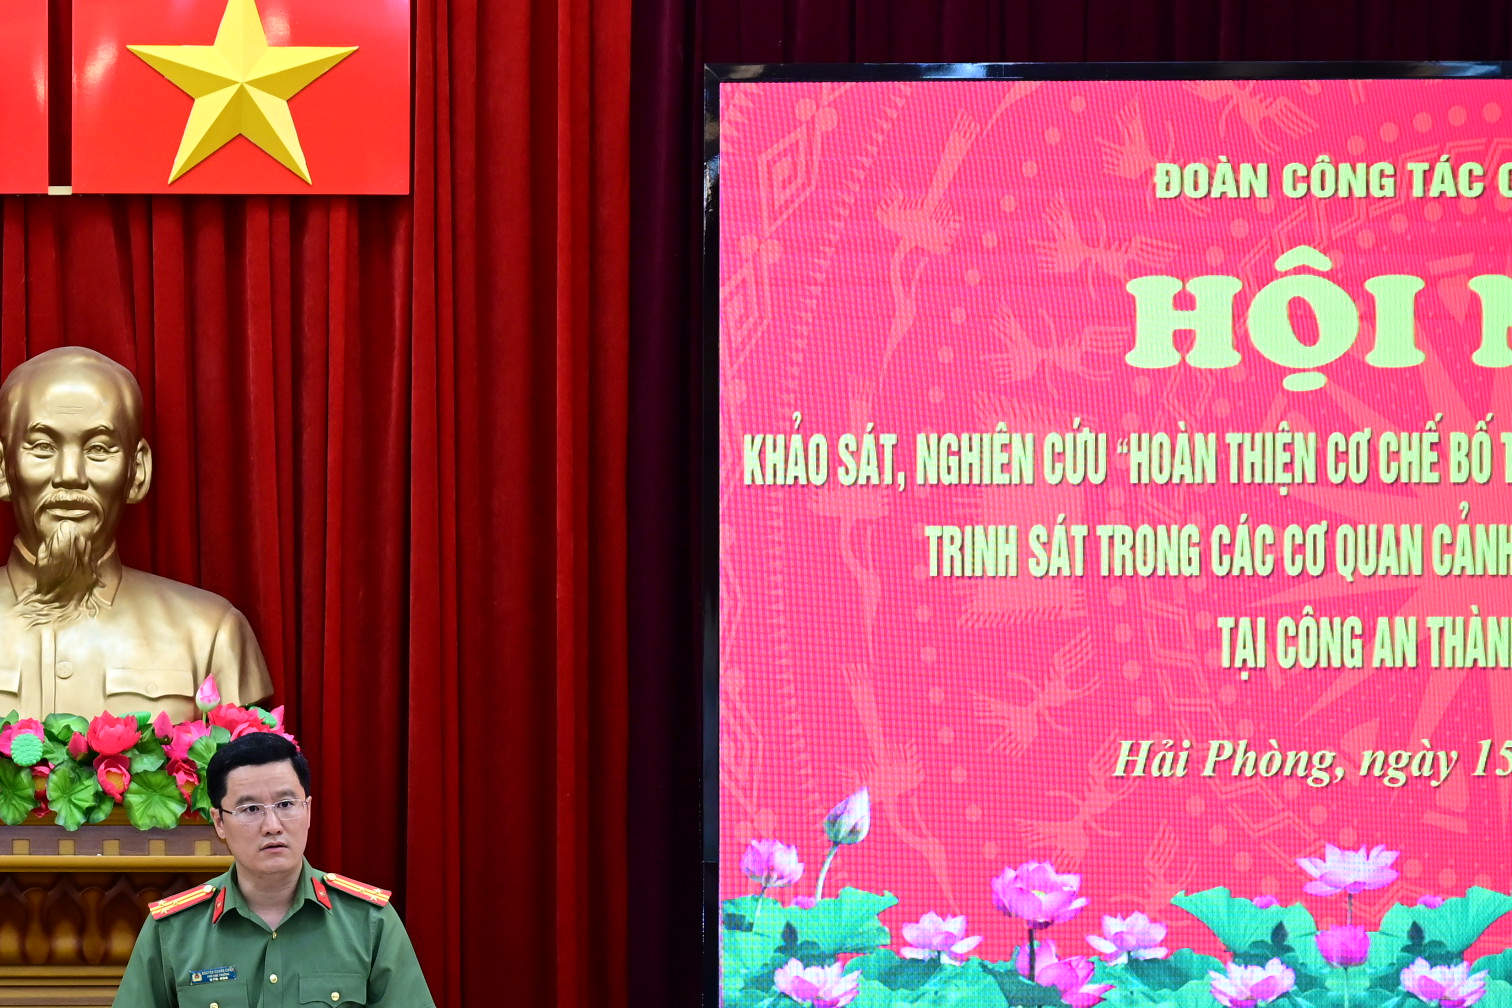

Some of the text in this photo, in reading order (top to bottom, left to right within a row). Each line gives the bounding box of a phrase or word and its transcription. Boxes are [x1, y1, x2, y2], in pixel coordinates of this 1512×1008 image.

[1153, 155, 1268, 199] ĐOÀN
[1282, 154, 1395, 199] CÔNG
[1407, 154, 1485, 199] TÁC
[1124, 244, 1427, 393] HỘI
[743, 411, 828, 486] KHẢO
[837, 421, 906, 491] SÁT,
[916, 420, 1035, 486] NGHIÊN
[1043, 416, 1108, 486] CỨU
[1225, 420, 1317, 496] THIỆN
[1326, 426, 1373, 485] CƠ
[1378, 412, 1443, 484] CHẾ
[1449, 412, 1494, 484] BỐ
[924, 524, 1019, 577] TRINH
[1028, 512, 1089, 578] SÁT
[1096, 523, 1201, 577] TRONG
[1210, 512, 1275, 577] CÁC
[1282, 519, 1328, 577] CƠ
[1335, 523, 1424, 583] QUAN
[1217, 604, 1512, 681] TẠI CÔNG AN THÀN
[1112, 738, 1512, 788] Hải Phòng, ngày 15
